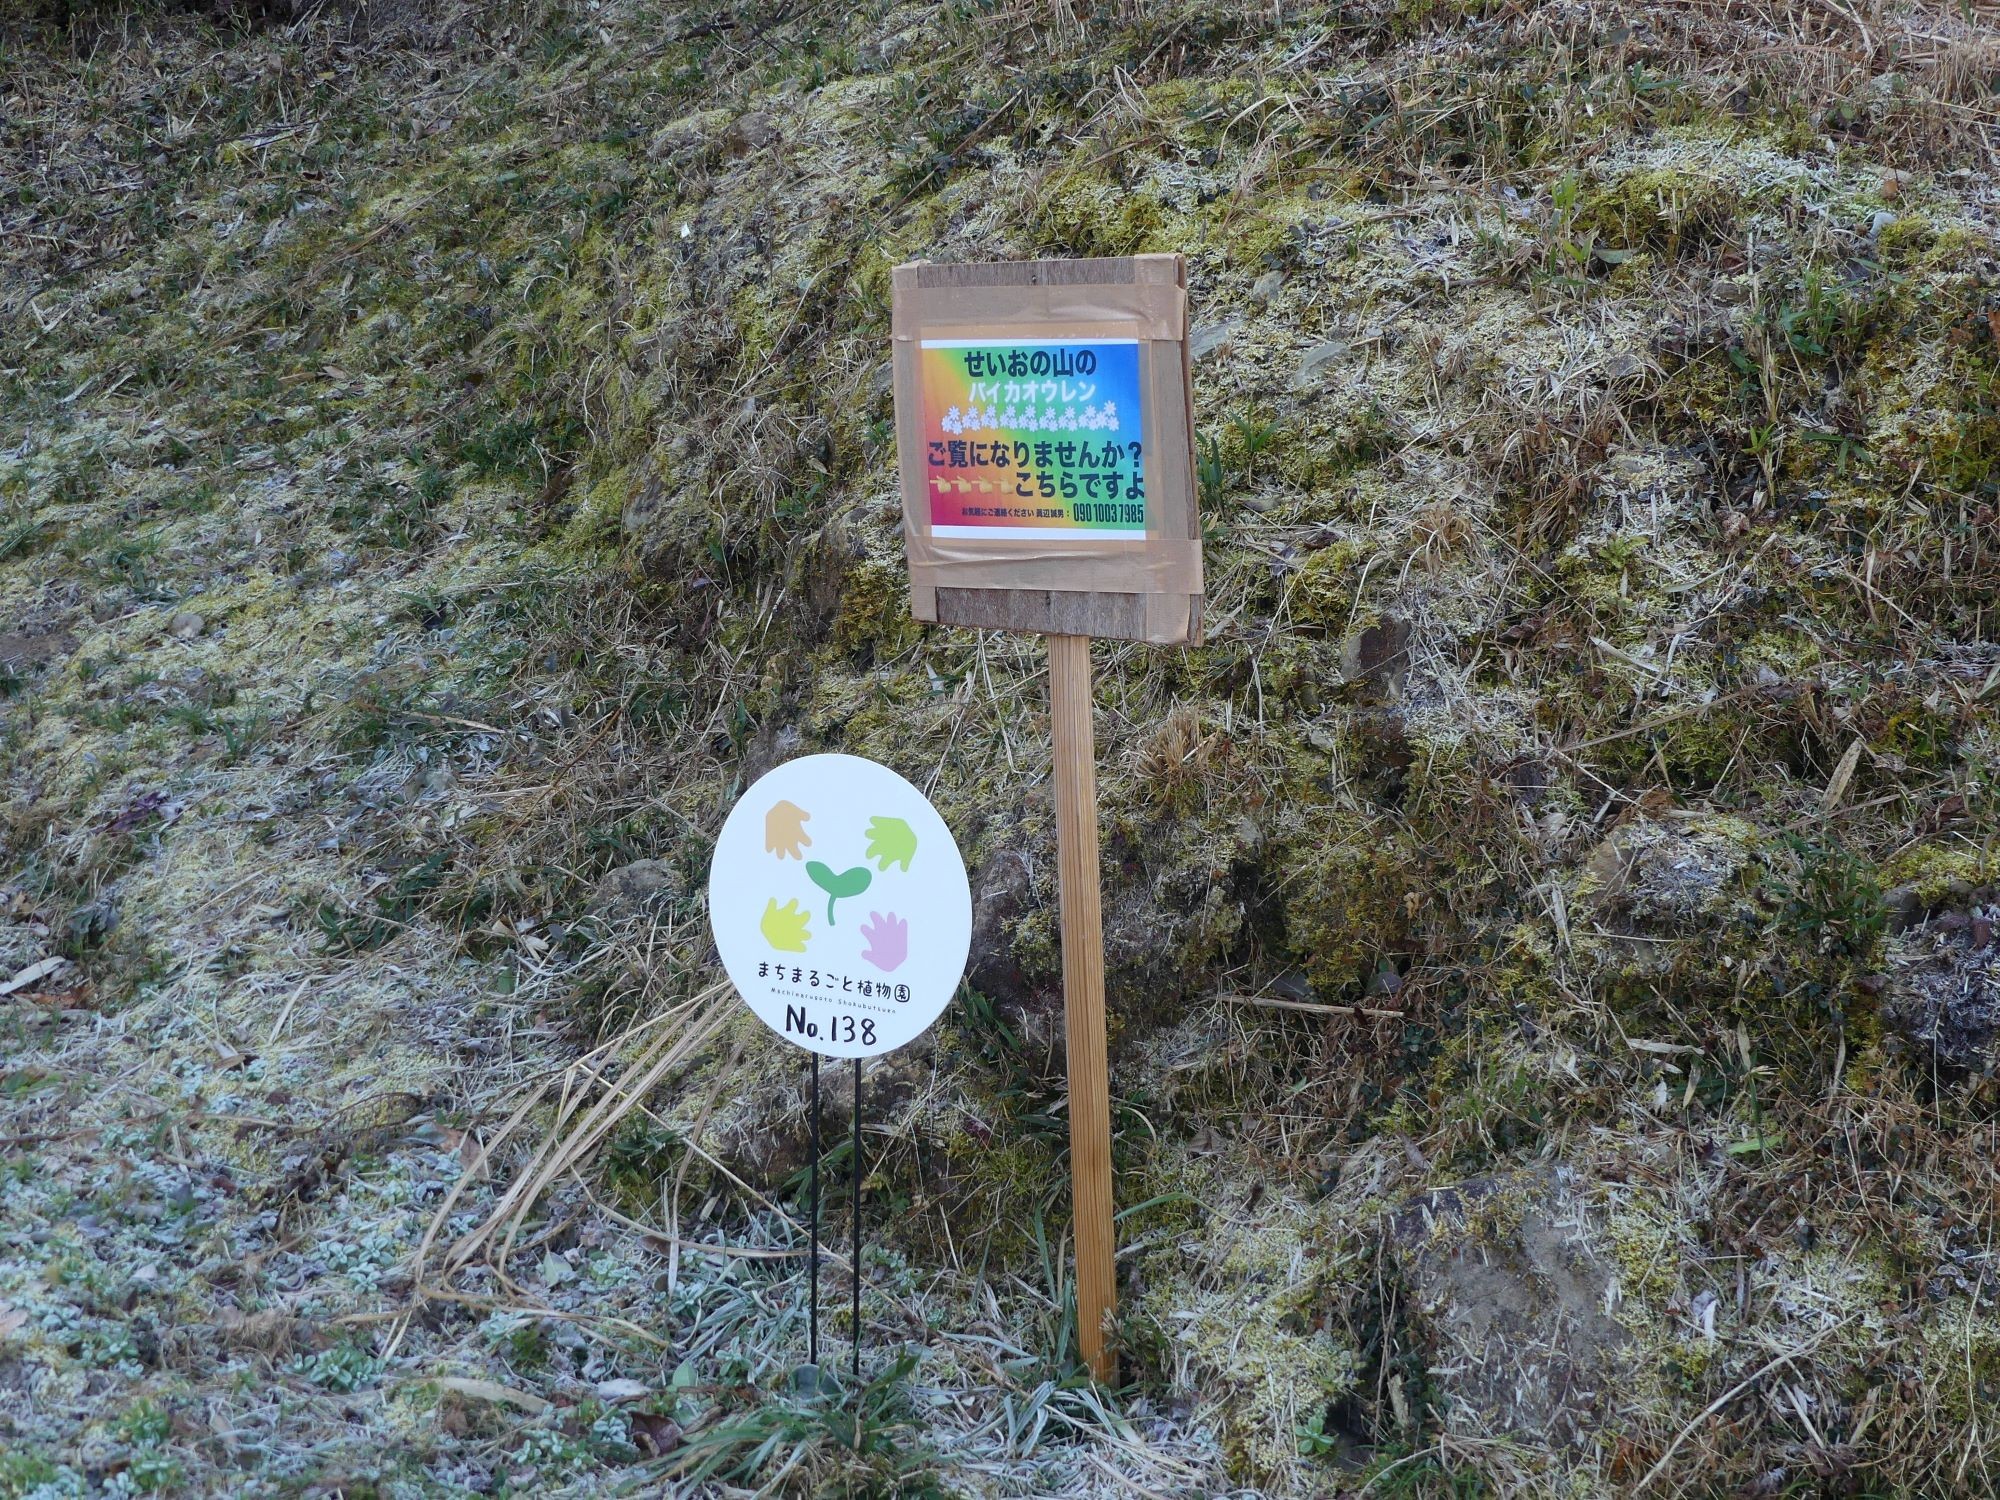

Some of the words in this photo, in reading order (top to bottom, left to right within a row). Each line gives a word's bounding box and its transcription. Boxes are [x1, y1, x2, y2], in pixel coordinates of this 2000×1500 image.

[964, 348, 1096, 377] せいおの山の
[969, 380, 1096, 403] バイカオウレン
[1016, 471, 1145, 499] こちらですよ
[1073, 503, 1092, 522] 090
[1093, 503, 1118, 523] 1003
[1118, 503, 1144, 523] 7985
[758, 961, 911, 1003] まちまるごと植物園
[831, 1015, 877, 1046] 138
